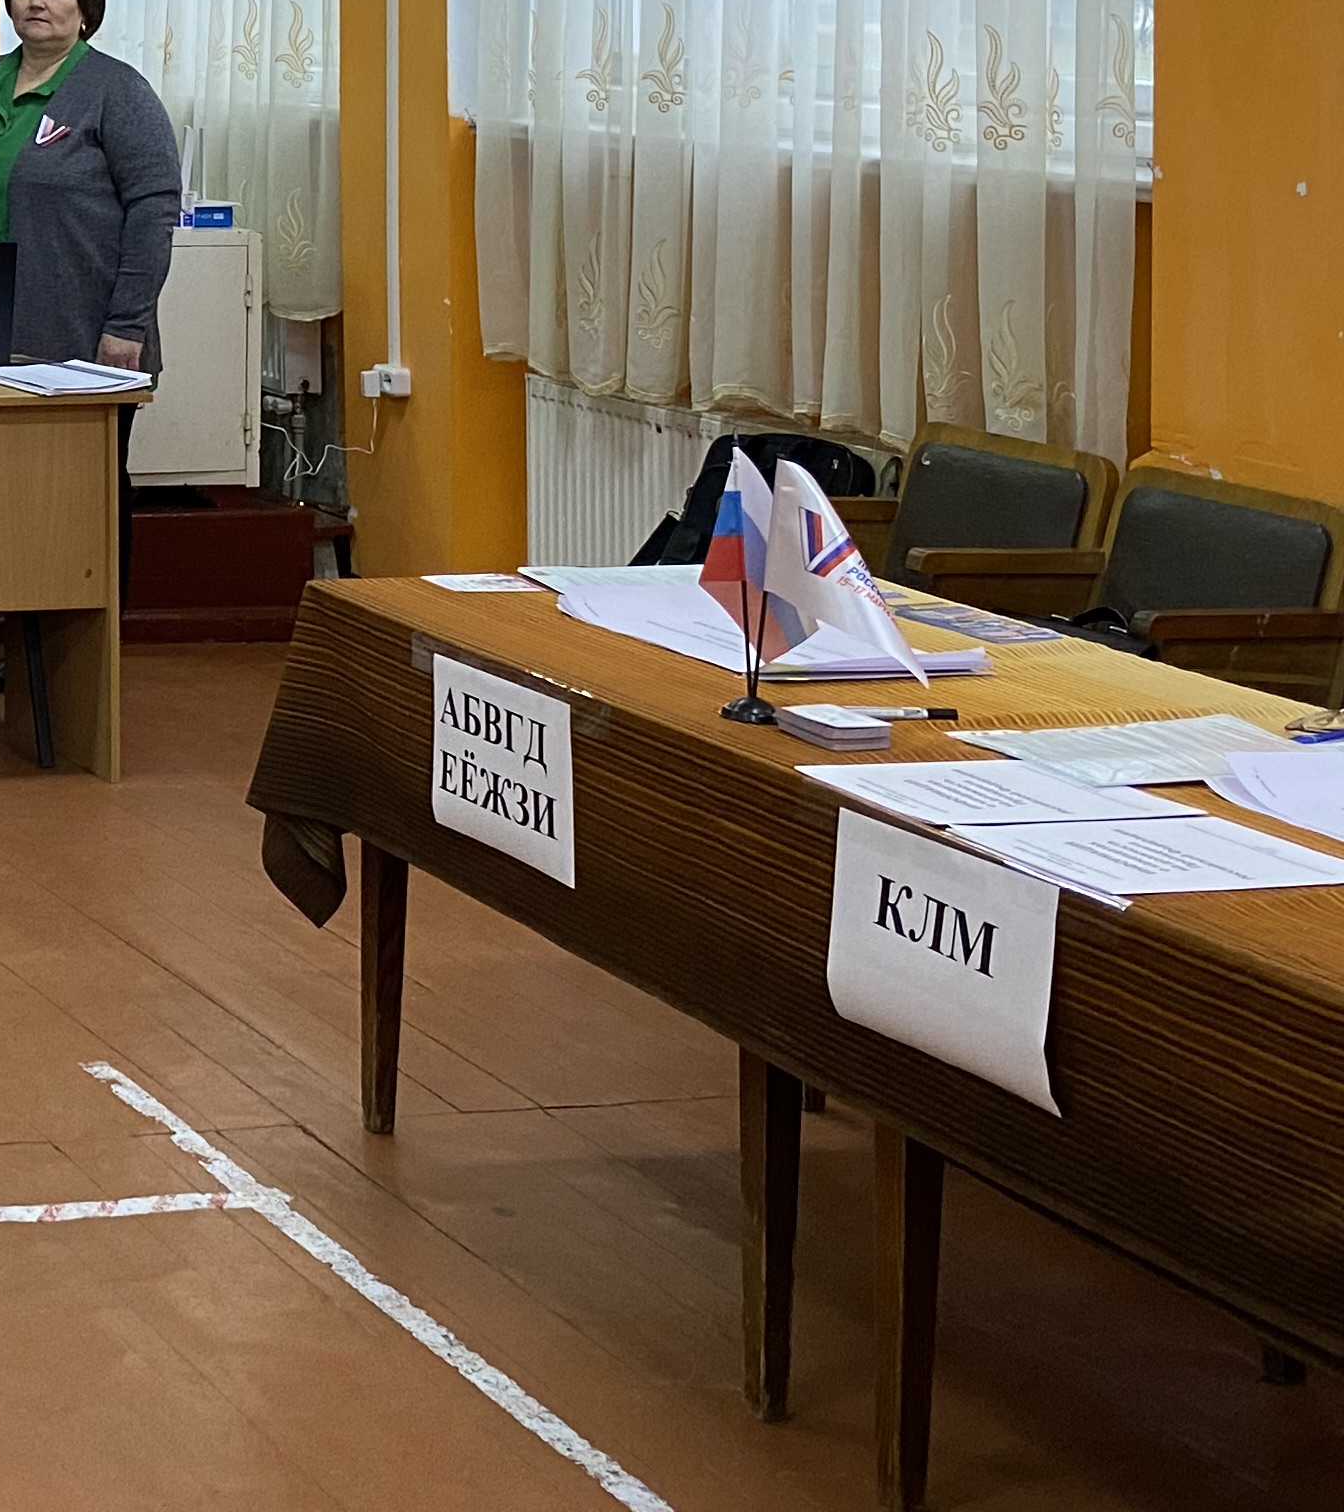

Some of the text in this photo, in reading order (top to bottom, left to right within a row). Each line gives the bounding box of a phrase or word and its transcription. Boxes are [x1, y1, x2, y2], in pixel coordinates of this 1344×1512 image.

[439, 686, 548, 778] АБВГД
[438, 748, 559, 841] ЕЁЖЗИ
[873, 874, 1000, 979] КЛМ
